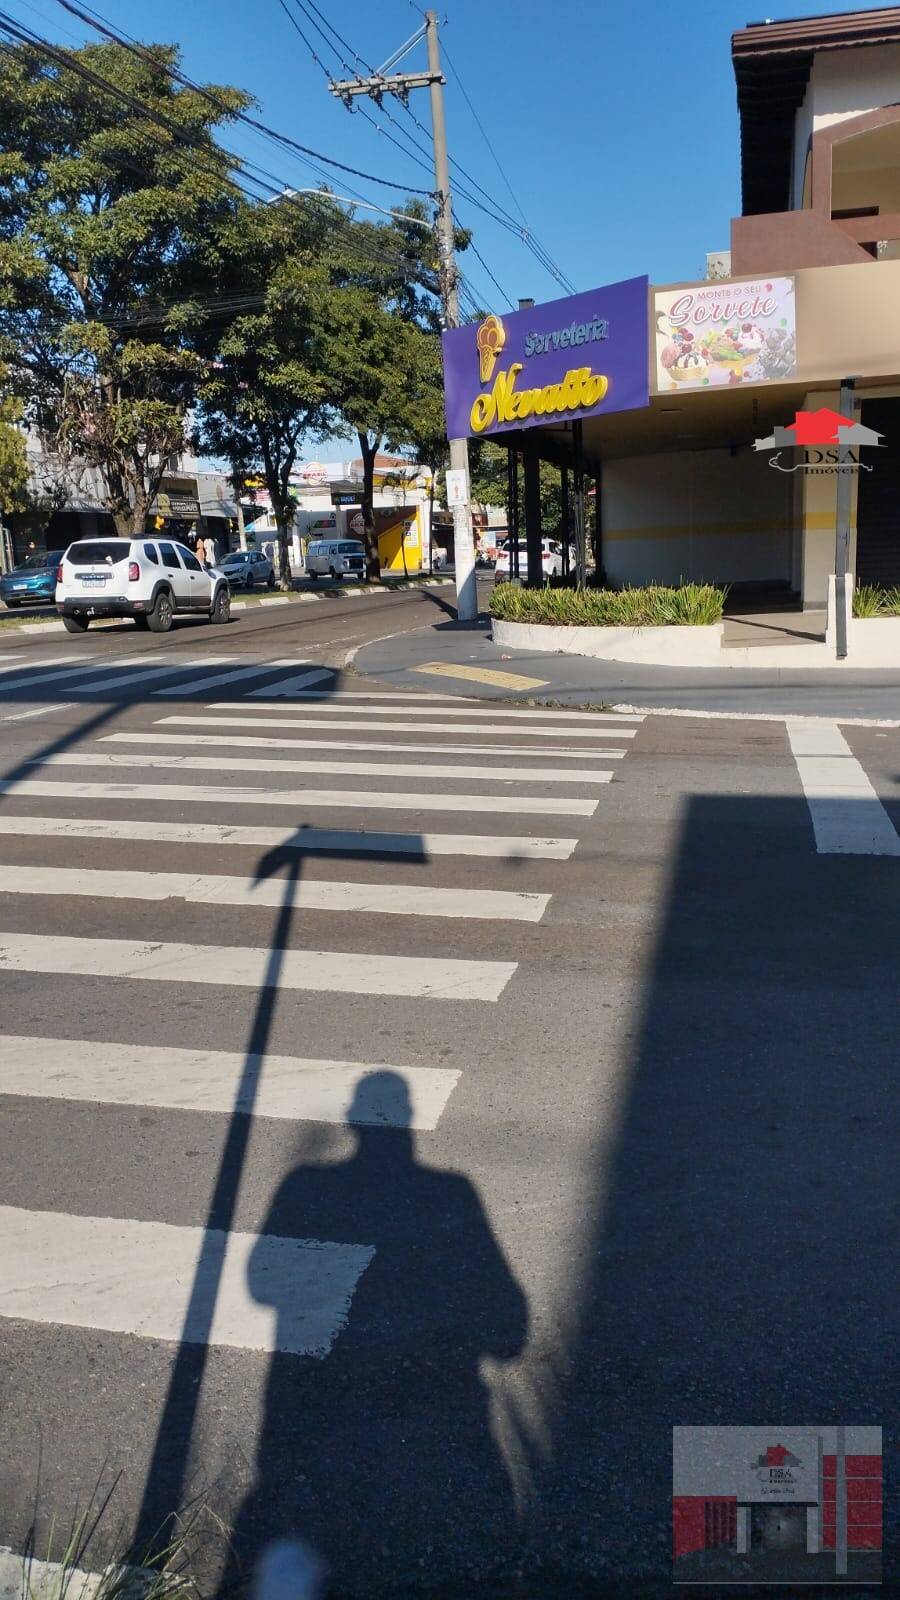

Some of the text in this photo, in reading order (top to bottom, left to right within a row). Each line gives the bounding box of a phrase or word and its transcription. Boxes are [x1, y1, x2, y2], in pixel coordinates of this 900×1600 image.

[697, 285, 762, 299] MONTE O SEU
[669, 294, 778, 327] Sorvete
[525, 314, 609, 357] Sorveteria
